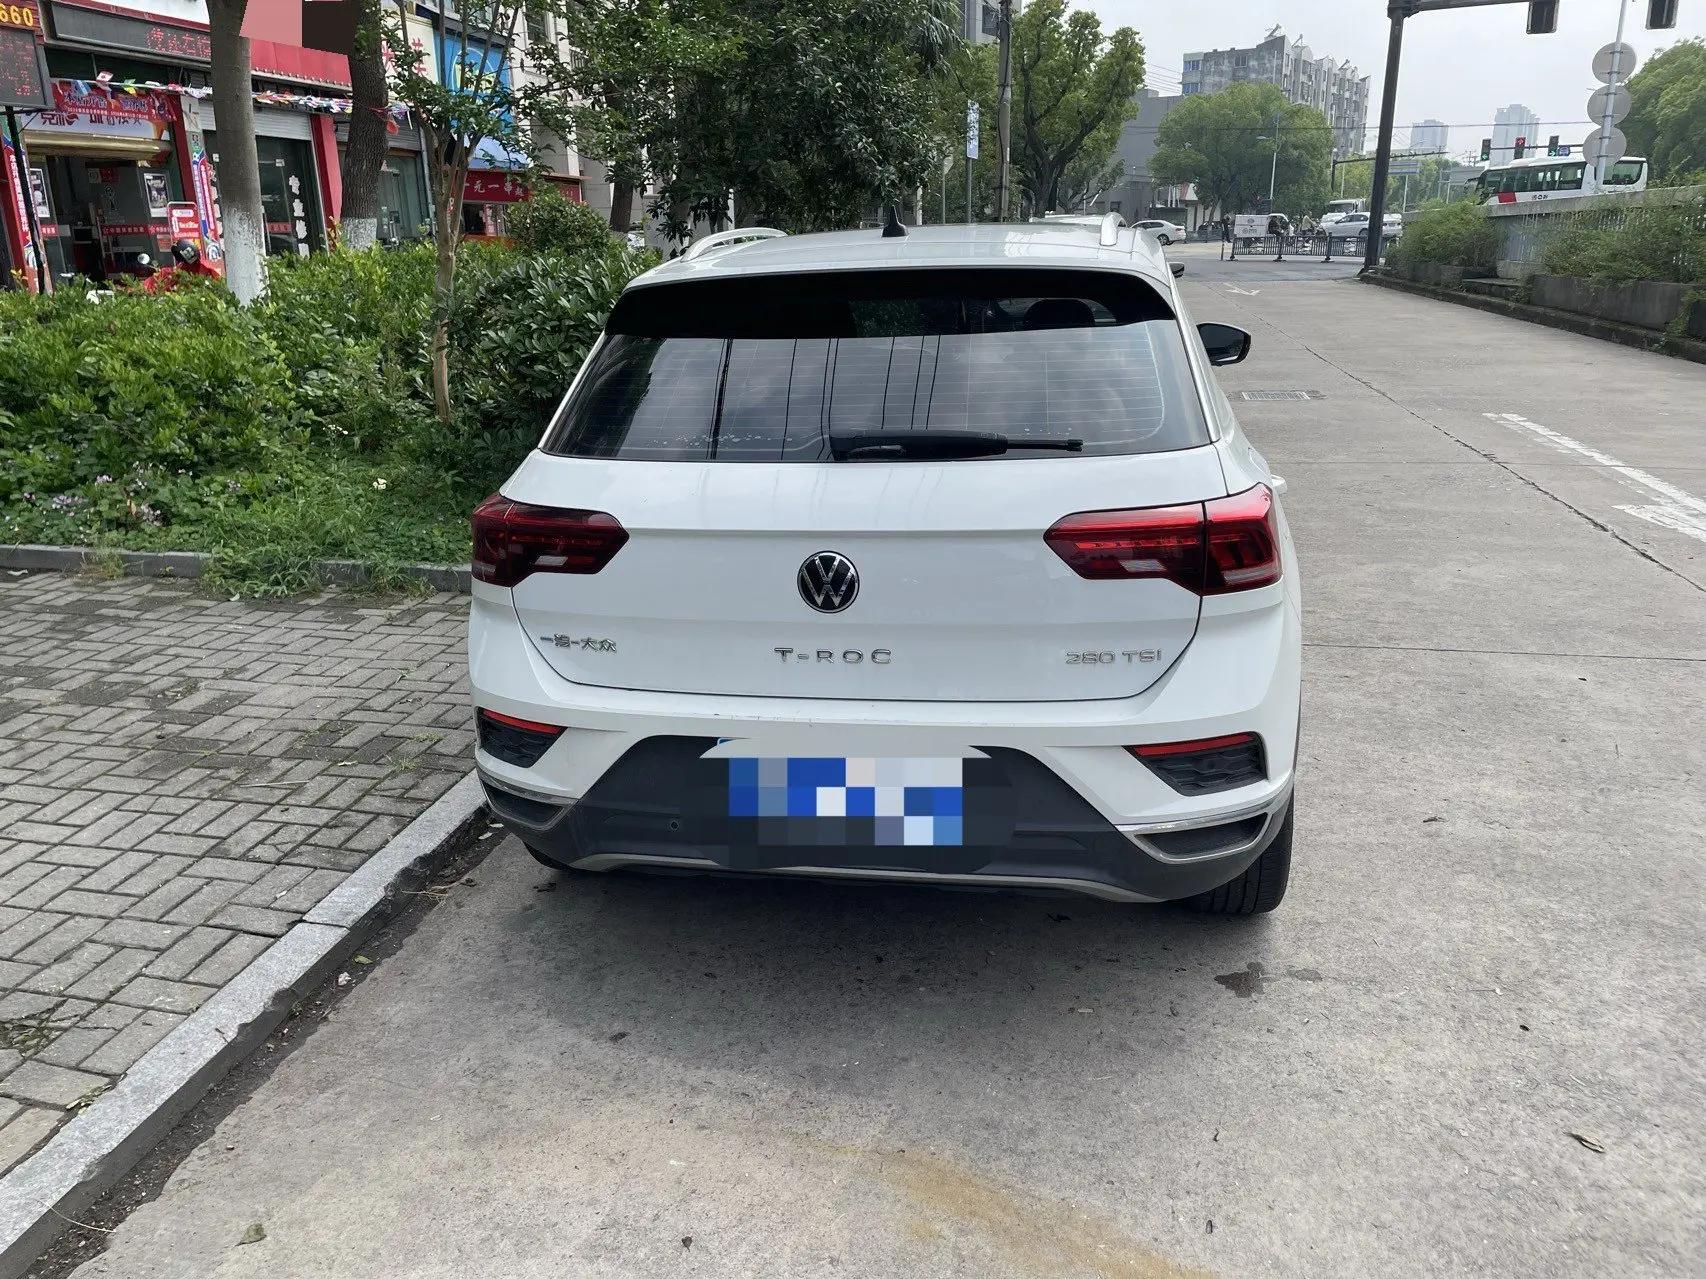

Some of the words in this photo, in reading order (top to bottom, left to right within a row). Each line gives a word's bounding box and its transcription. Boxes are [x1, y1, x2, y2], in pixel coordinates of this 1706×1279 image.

[540, 633, 617, 653] 一汽-大众
[773, 647, 893, 665] T-ROC
[1065, 651, 1116, 665] 280
[1121, 648, 1162, 664] TSI
